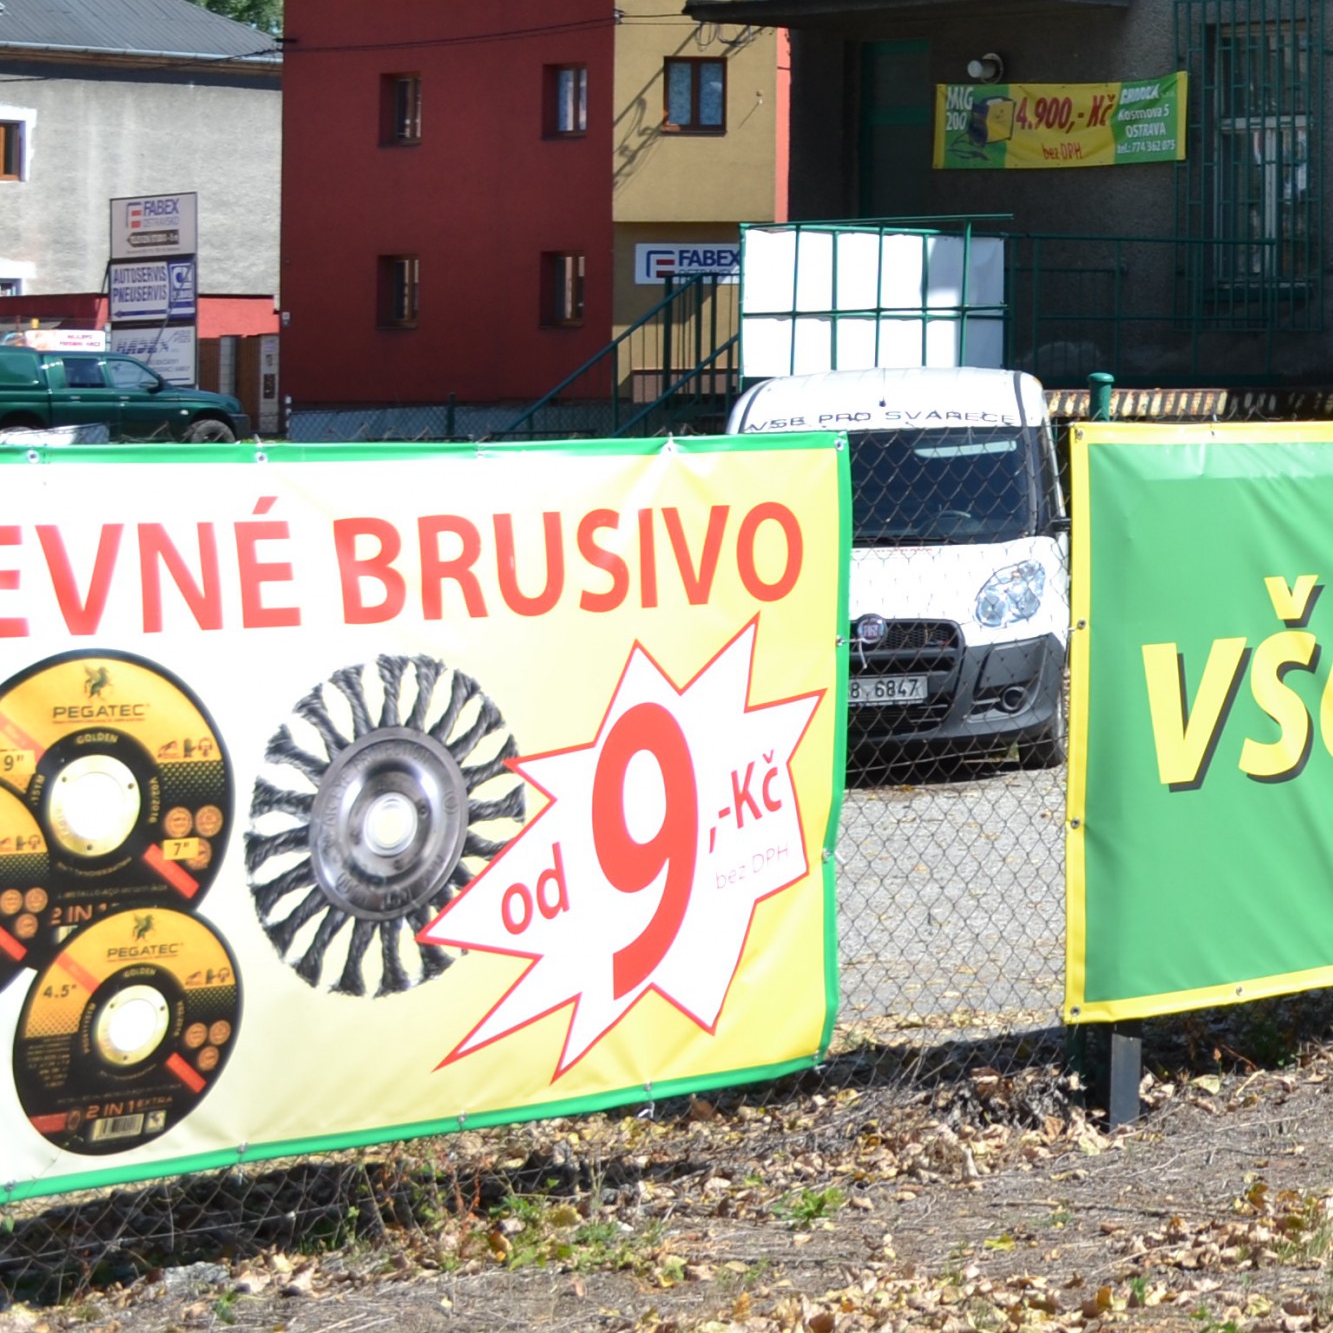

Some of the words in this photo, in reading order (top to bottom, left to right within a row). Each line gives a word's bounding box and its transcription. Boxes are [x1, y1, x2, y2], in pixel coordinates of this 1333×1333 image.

[947, 86, 974, 110] MIG
[1016, 97, 1084, 133] 4.900,-
[1087, 94, 1115, 128] Kč
[1164, 103, 1170, 117] 5
[946, 112, 968, 131] 200
[1125, 122, 1166, 138] OSTRAVA
[1042, 144, 1060, 160] bez
[1061, 143, 1082, 160] DPH
[143, 199, 179, 216] FABEX
[679, 250, 740, 267] FABEX
[113, 266, 167, 285] AUTOSERVIS
[113, 284, 167, 304] PNEUSERVIS
[334, 502, 803, 626] BRUSIVO
[875, 679, 918, 698] 6847
[53, 704, 145, 719] PEGATEC
[75, 732, 119, 745] GOLDEN
[592, 702, 699, 1001] 9
[715, 864, 746, 889] bez
[752, 844, 789, 872] DPH
[501, 841, 570, 935] od
[67, 904, 93, 924] IN
[107, 943, 179, 958] PEGATEC
[123, 968, 157, 978] GOLDEN
[86, 1105, 100, 1119] 2
[104, 1102, 125, 1116] IN
[129, 1100, 135, 1113] 1
